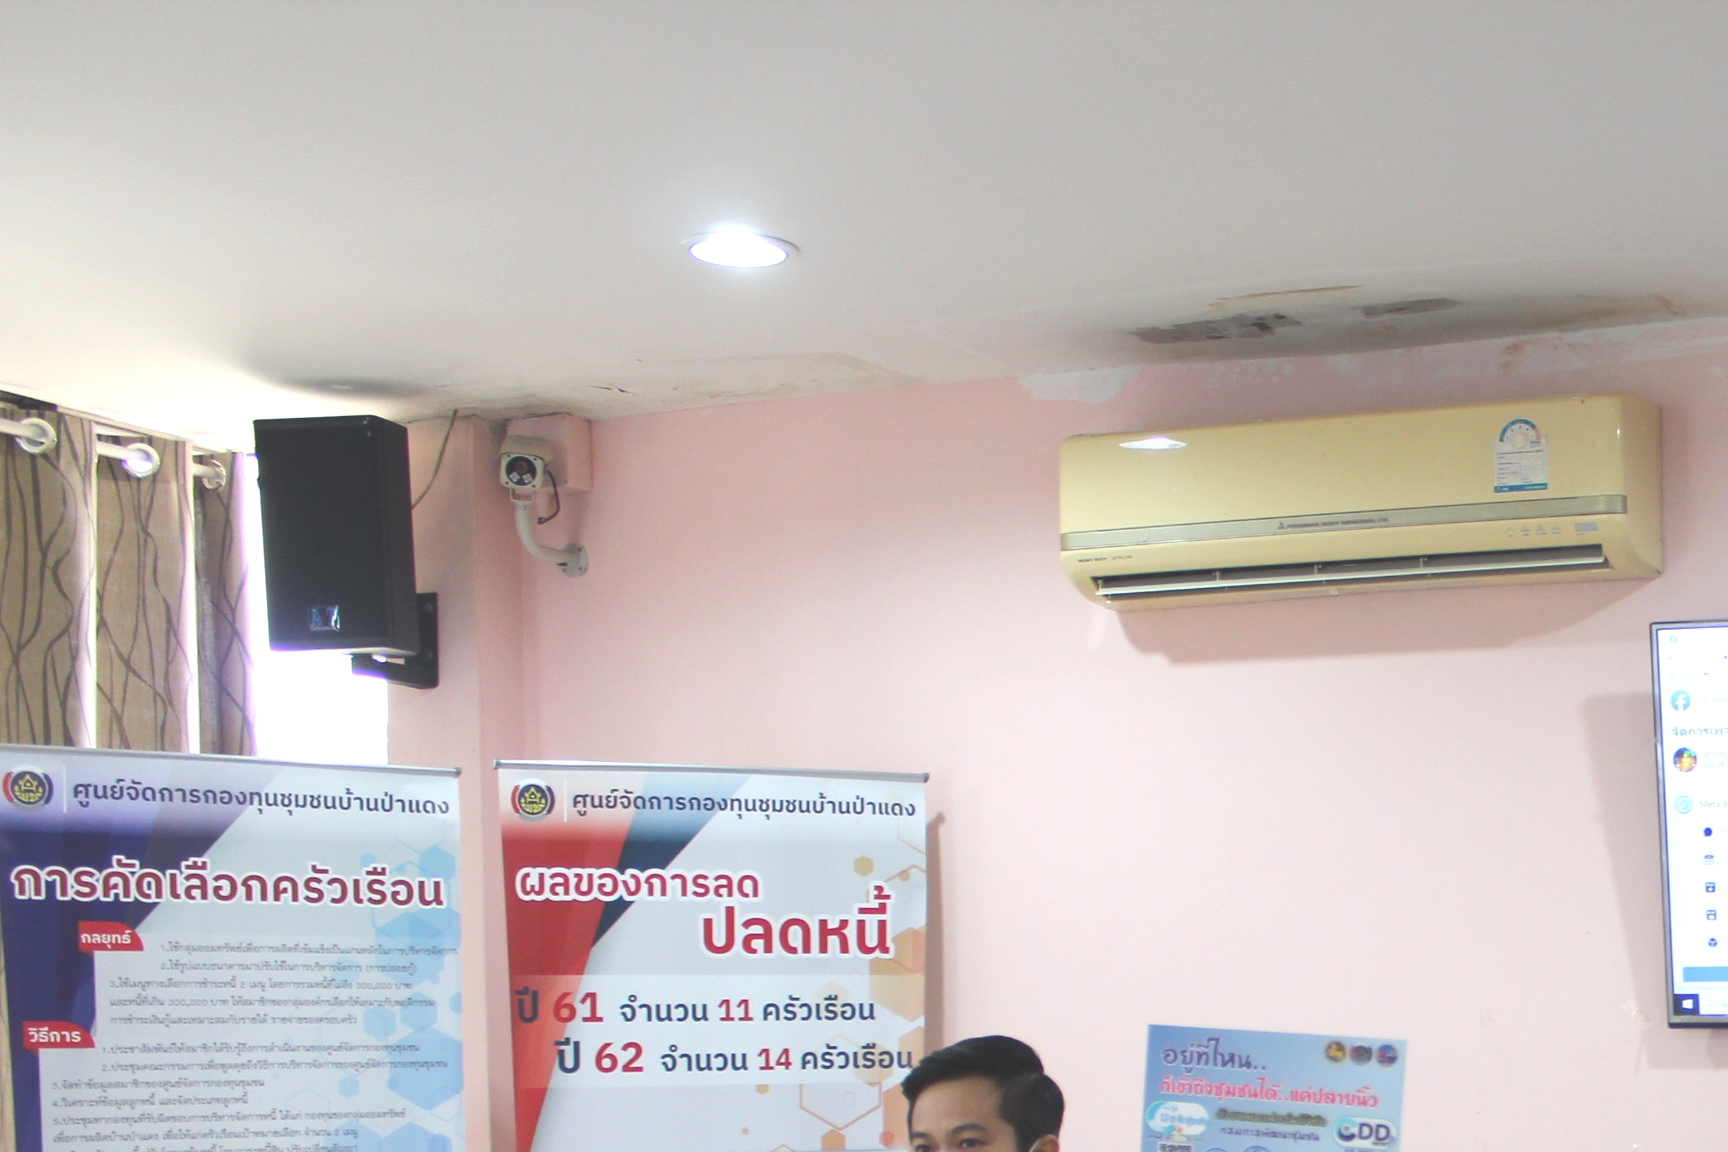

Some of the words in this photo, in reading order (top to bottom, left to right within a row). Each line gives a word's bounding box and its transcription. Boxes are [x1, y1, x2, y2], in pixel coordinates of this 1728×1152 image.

[73, 779, 449, 815] ศูนย์จัดการกองทุนชุมชนบ้านป่าแดง
[573, 789, 915, 820] ศูนย์จัดการกองทุนชุมชนบ้านป่าแดง
[13, 857, 445, 907] การคัดเลือกครัวเรือน
[520, 870, 760, 898] ผลของการลด
[702, 885, 891, 955] ปลดหนี้
[81, 930, 132, 949] กลยุทธ์
[355, 982, 392, 990] 300,000
[168, 999, 208, 1007] 300,000
[515, 987, 537, 1024] ปี
[553, 992, 604, 1023] 61
[619, 994, 709, 1022] จำนวน
[719, 999, 754, 1022] 11
[762, 996, 876, 1022] ครัวเรือน
[28, 1027, 81, 1043] วิธีการ
[555, 1037, 581, 1075] ปี
[594, 1043, 644, 1073] 62
[660, 1045, 748, 1073] จำนวน
[757, 1048, 793, 1071] 14
[801, 1045, 912, 1072] ครัวเรือน
[1338, 1118, 1392, 1142] CDD
